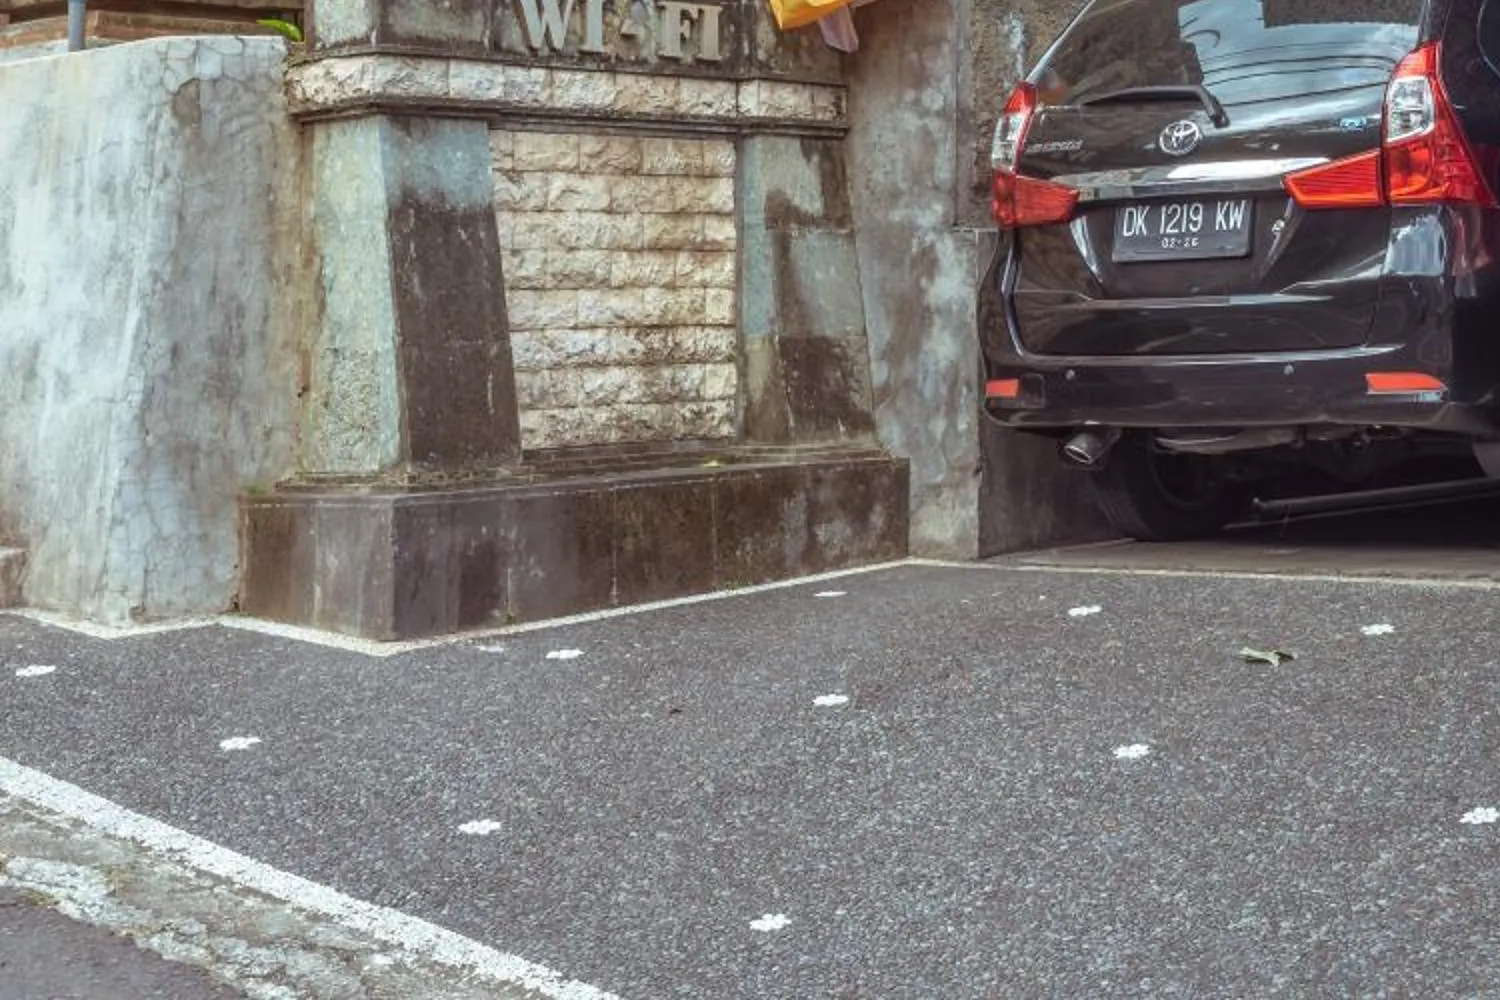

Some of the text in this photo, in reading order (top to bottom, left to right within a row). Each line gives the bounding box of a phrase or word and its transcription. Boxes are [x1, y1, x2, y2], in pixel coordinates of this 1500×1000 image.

[1122, 199, 1249, 237] DK 1219 KW
